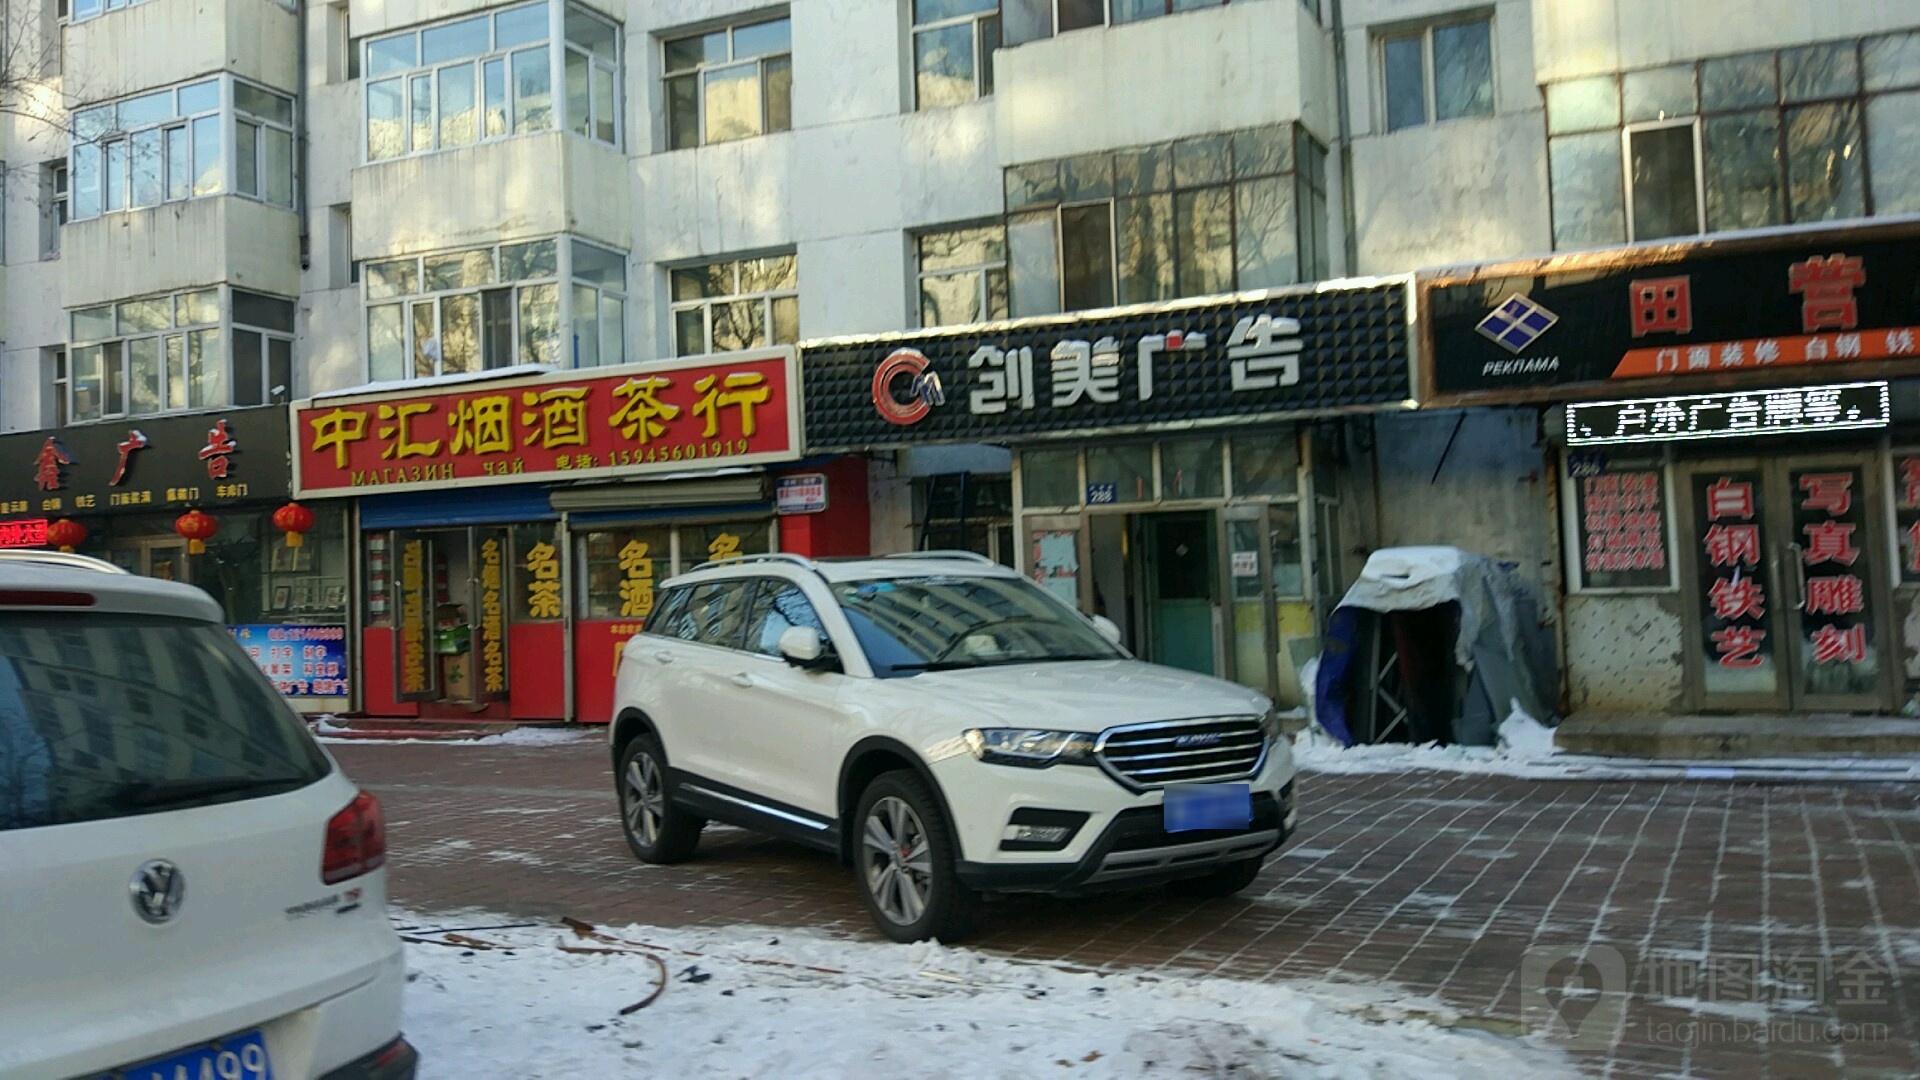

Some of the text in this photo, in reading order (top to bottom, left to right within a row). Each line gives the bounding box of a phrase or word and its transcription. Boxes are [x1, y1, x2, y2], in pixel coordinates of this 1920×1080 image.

[967, 314, 1304, 415] 创美广告
[311, 372, 773, 470] 中汇烟酒茶行
[609, 438, 749, 467] 15945601919
[351, 463, 456, 487] МАГАЗИН
[481, 538, 504, 692] 名烟名酒名茶
[526, 541, 562, 619] 名茶
[618, 539, 654, 618] 名酒
[1704, 477, 1768, 668] 白钢铁艺
[1799, 471, 1867, 663] 写真雕刻
